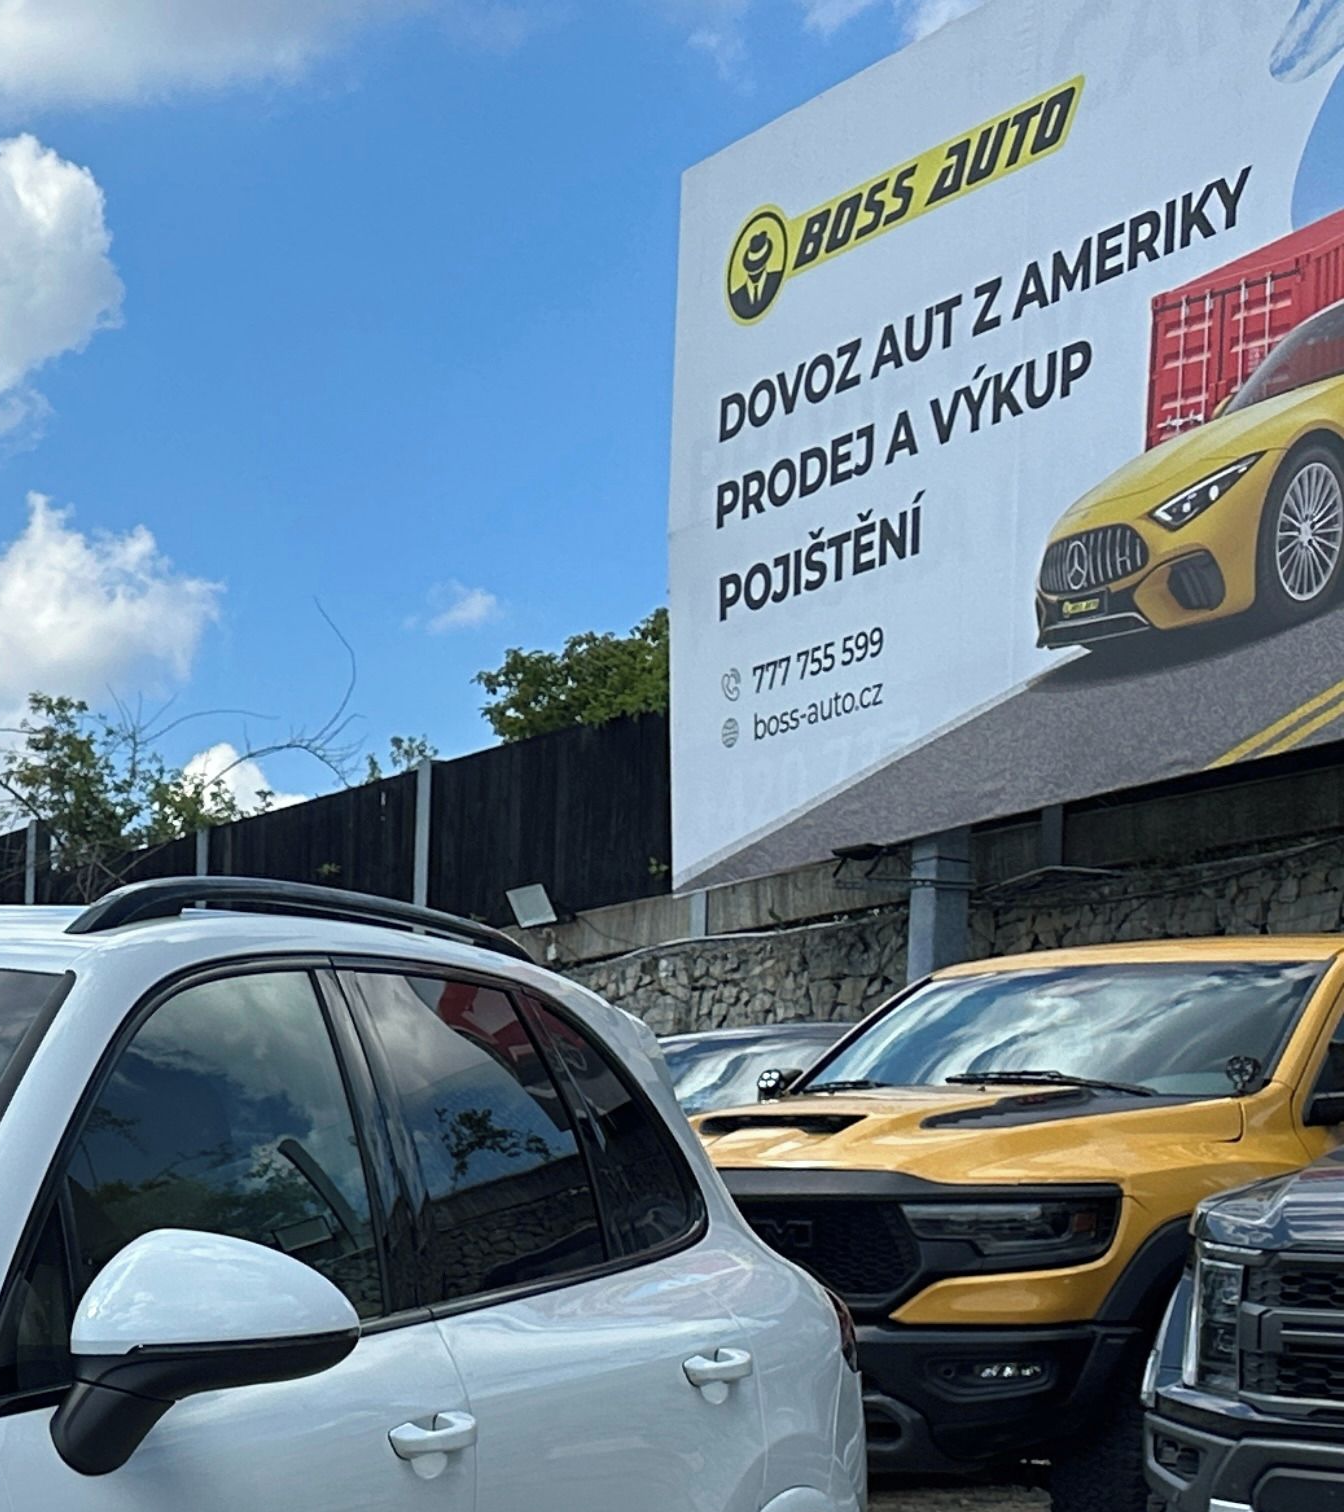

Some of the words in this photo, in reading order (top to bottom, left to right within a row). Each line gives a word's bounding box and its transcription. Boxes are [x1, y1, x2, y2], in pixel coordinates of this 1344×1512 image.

[792, 163, 918, 271] BOSS
[924, 86, 1076, 206] AUTO
[718, 338, 862, 443] DOVOZ
[870, 295, 963, 380] AUT
[972, 277, 1003, 337] Z
[1012, 165, 1253, 321] AMERIKY
[716, 423, 875, 530] PRODEJ
[884, 410, 919, 465] A
[929, 340, 1093, 445] VÝKUP
[718, 490, 926, 622] POJIŠTĚNÍ
[752, 655, 792, 694] 777
[796, 641, 836, 681] 755
[841, 626, 884, 667] 599
[753, 683, 884, 741] boss-auto.cz
